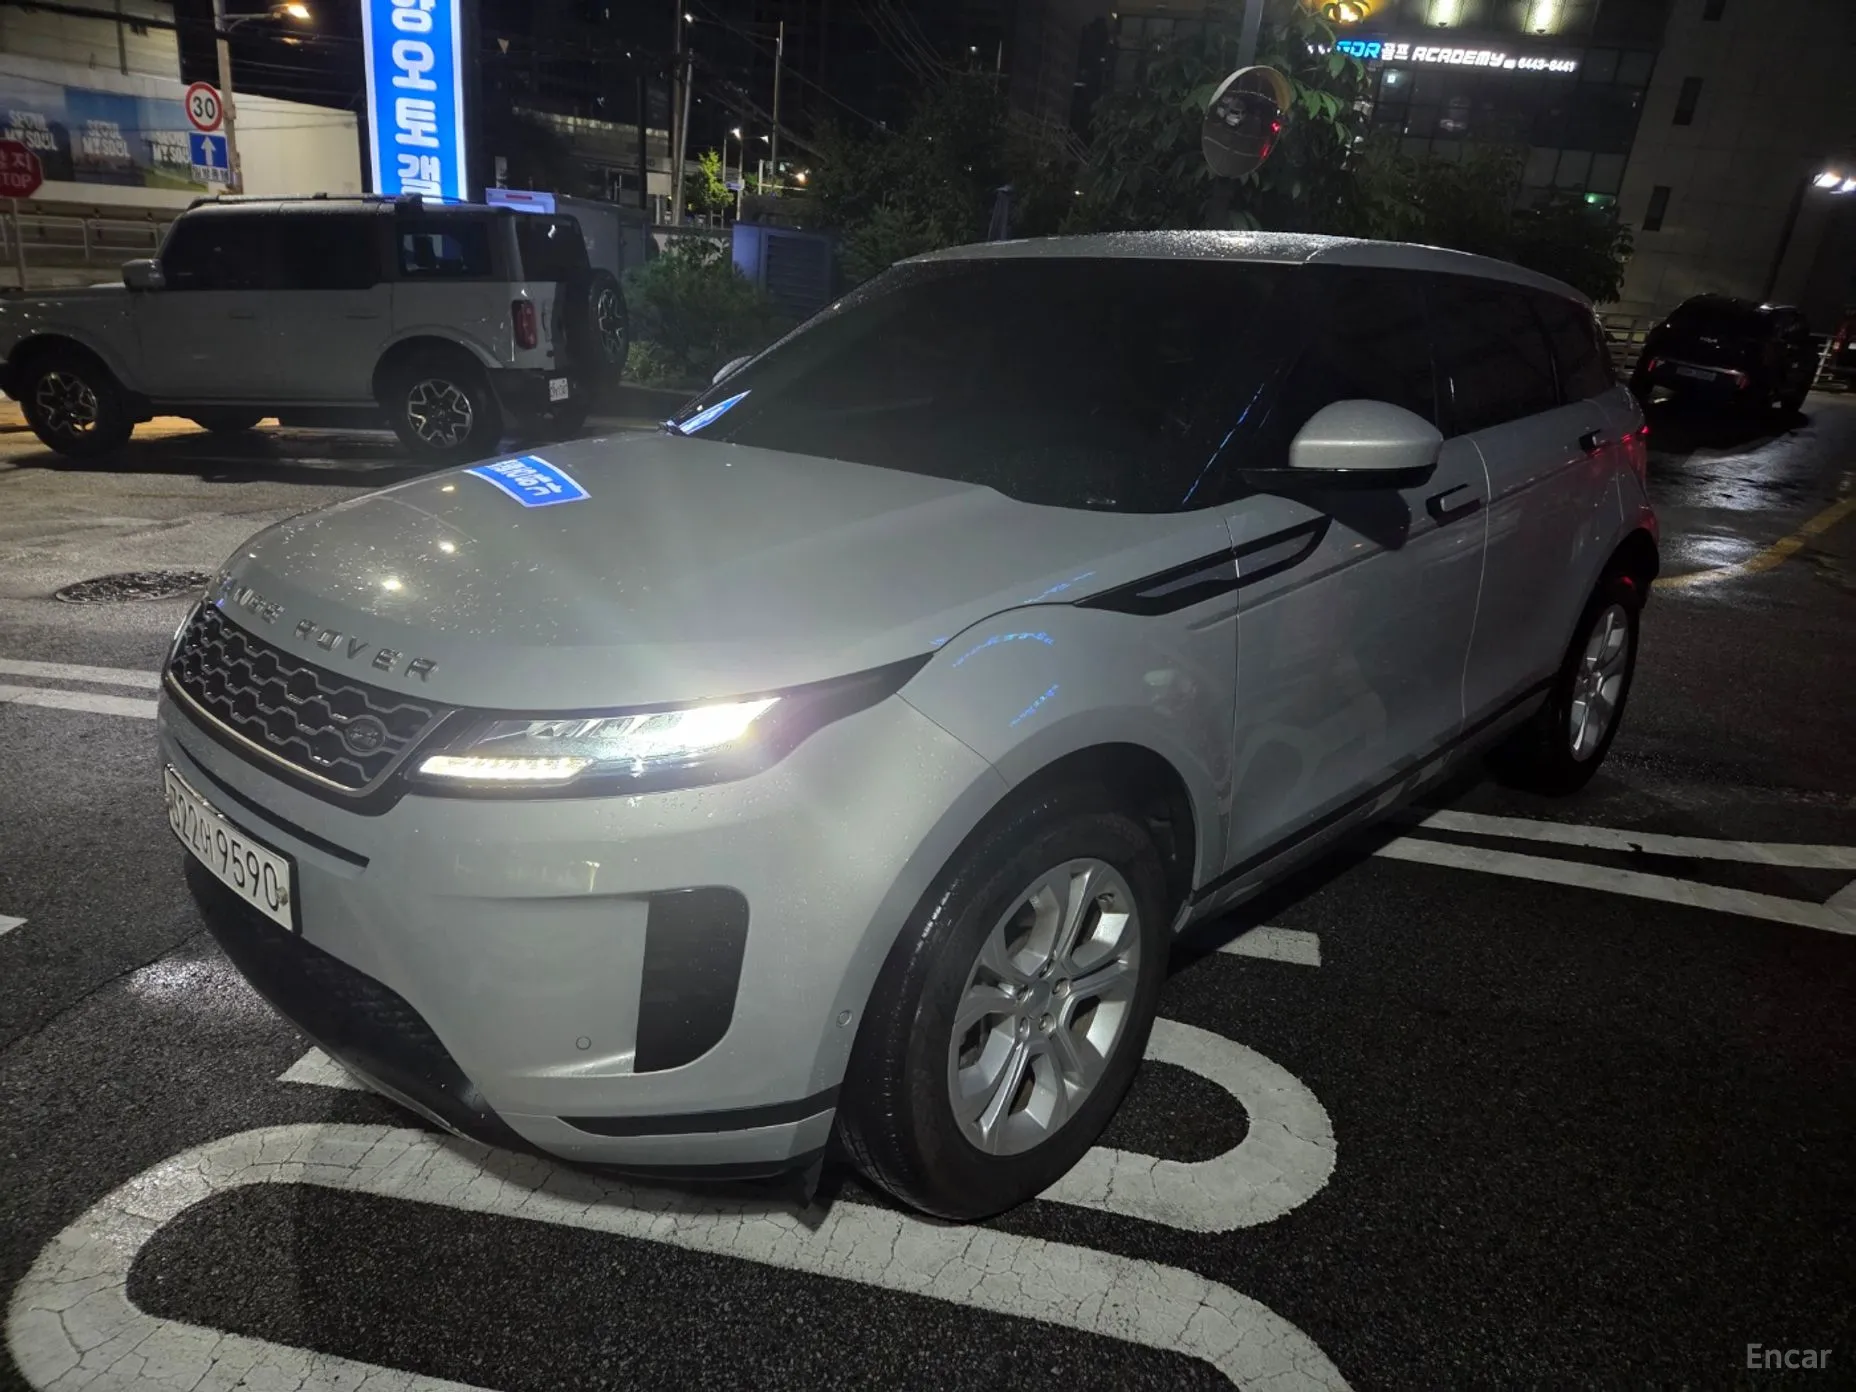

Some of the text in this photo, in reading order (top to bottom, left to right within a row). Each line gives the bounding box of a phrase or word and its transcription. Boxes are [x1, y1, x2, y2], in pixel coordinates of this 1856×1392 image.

[1411, 46, 1506, 68] ACADEMY
[193, 96, 215, 119] 30
[87, 120, 122, 139] SEOUL
[102, 139, 131, 158] SOUL
[0, 173, 32, 189] TOP
[292, 617, 440, 683] ROVER
